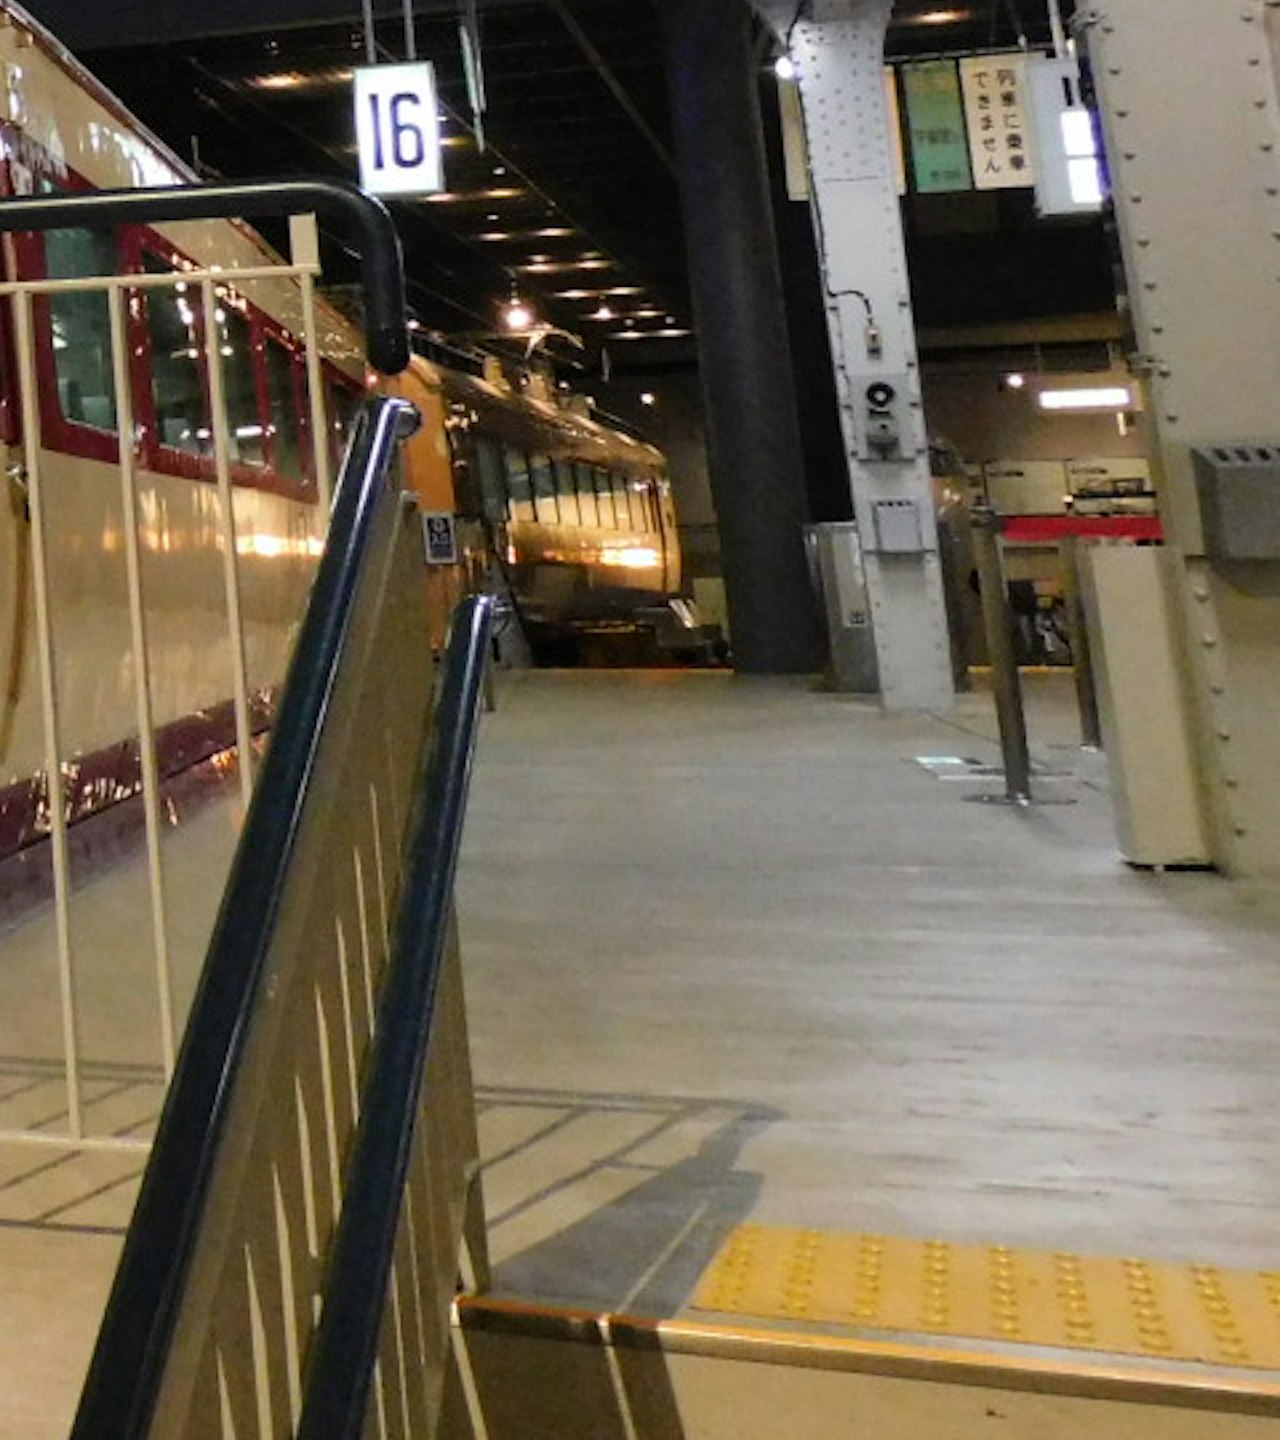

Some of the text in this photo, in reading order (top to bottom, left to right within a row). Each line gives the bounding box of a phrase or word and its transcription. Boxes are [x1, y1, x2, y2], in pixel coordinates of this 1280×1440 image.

[368, 92, 424, 170] 16
[973, 71, 1001, 173] できません
